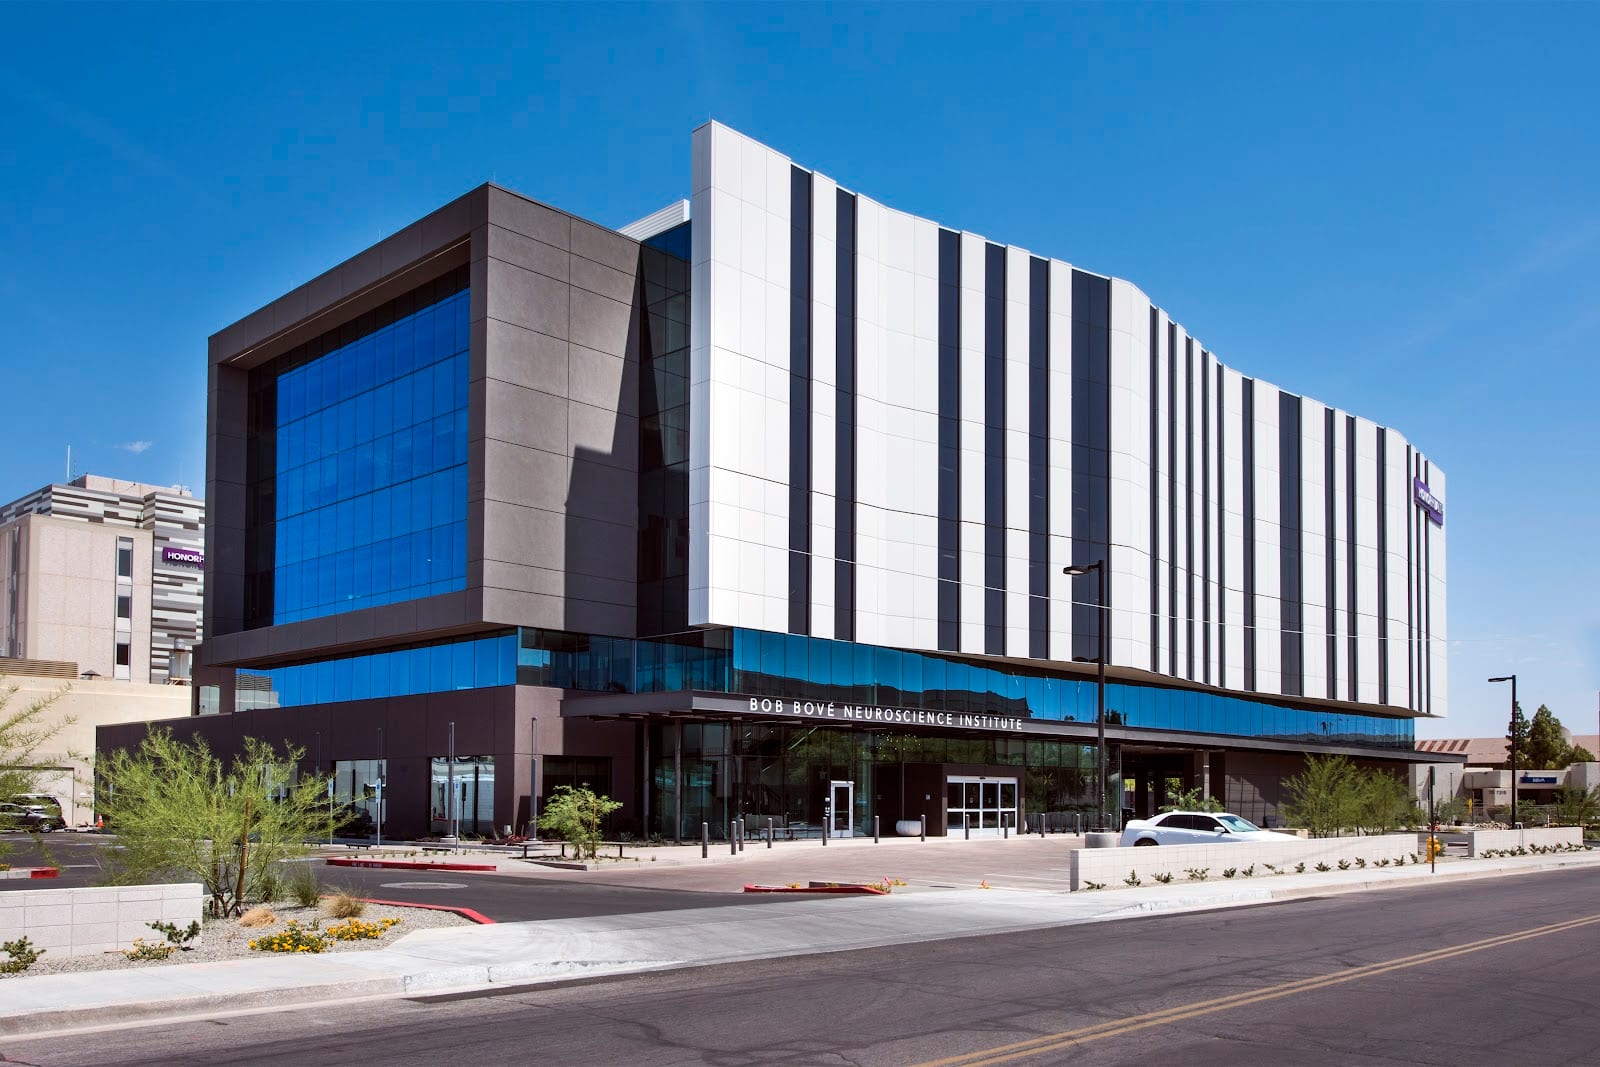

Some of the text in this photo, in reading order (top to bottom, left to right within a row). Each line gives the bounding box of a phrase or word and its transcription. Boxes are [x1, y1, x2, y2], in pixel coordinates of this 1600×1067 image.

[749, 697, 1022, 730] BOB BOVÉ NEUROSCIENCE INSTITUTE
